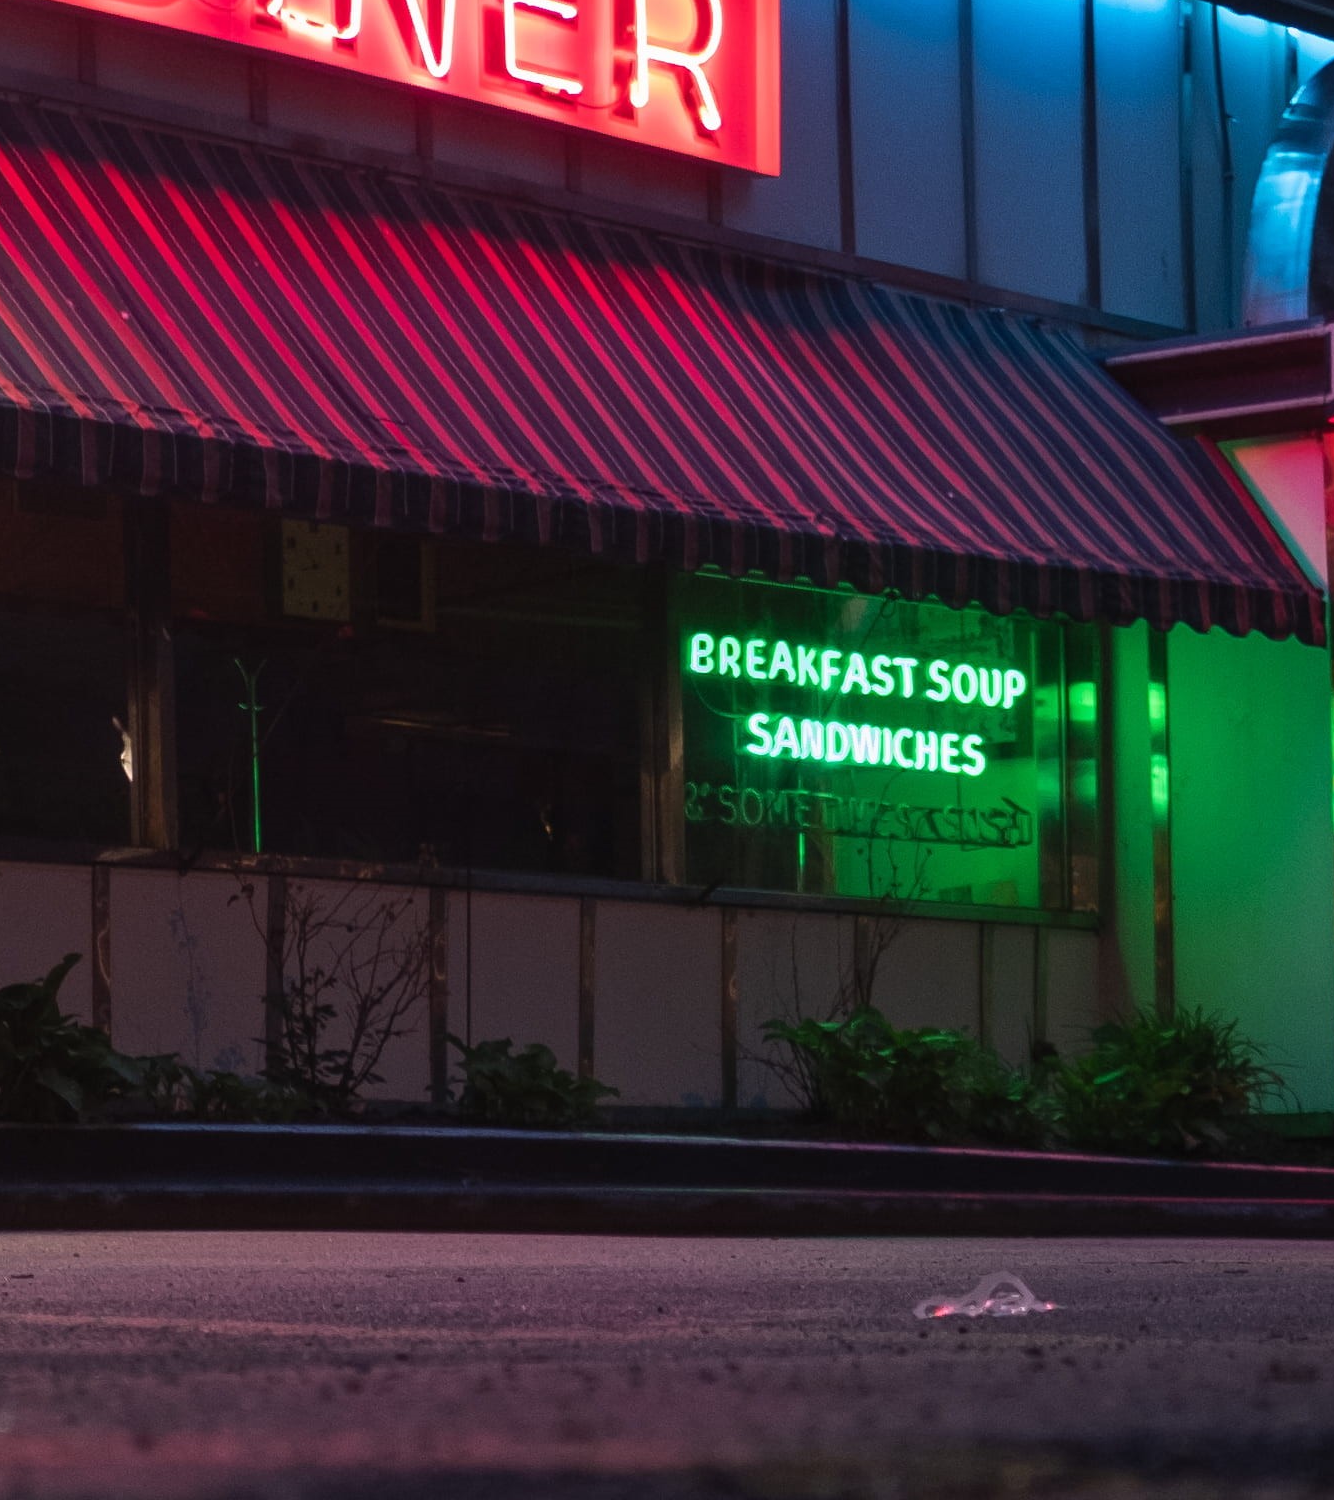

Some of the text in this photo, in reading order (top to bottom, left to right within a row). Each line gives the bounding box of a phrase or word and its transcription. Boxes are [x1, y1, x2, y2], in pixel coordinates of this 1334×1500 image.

[688, 632, 1027, 709] BREAKFAST SOUP
[745, 712, 987, 777] SANDWICHES
